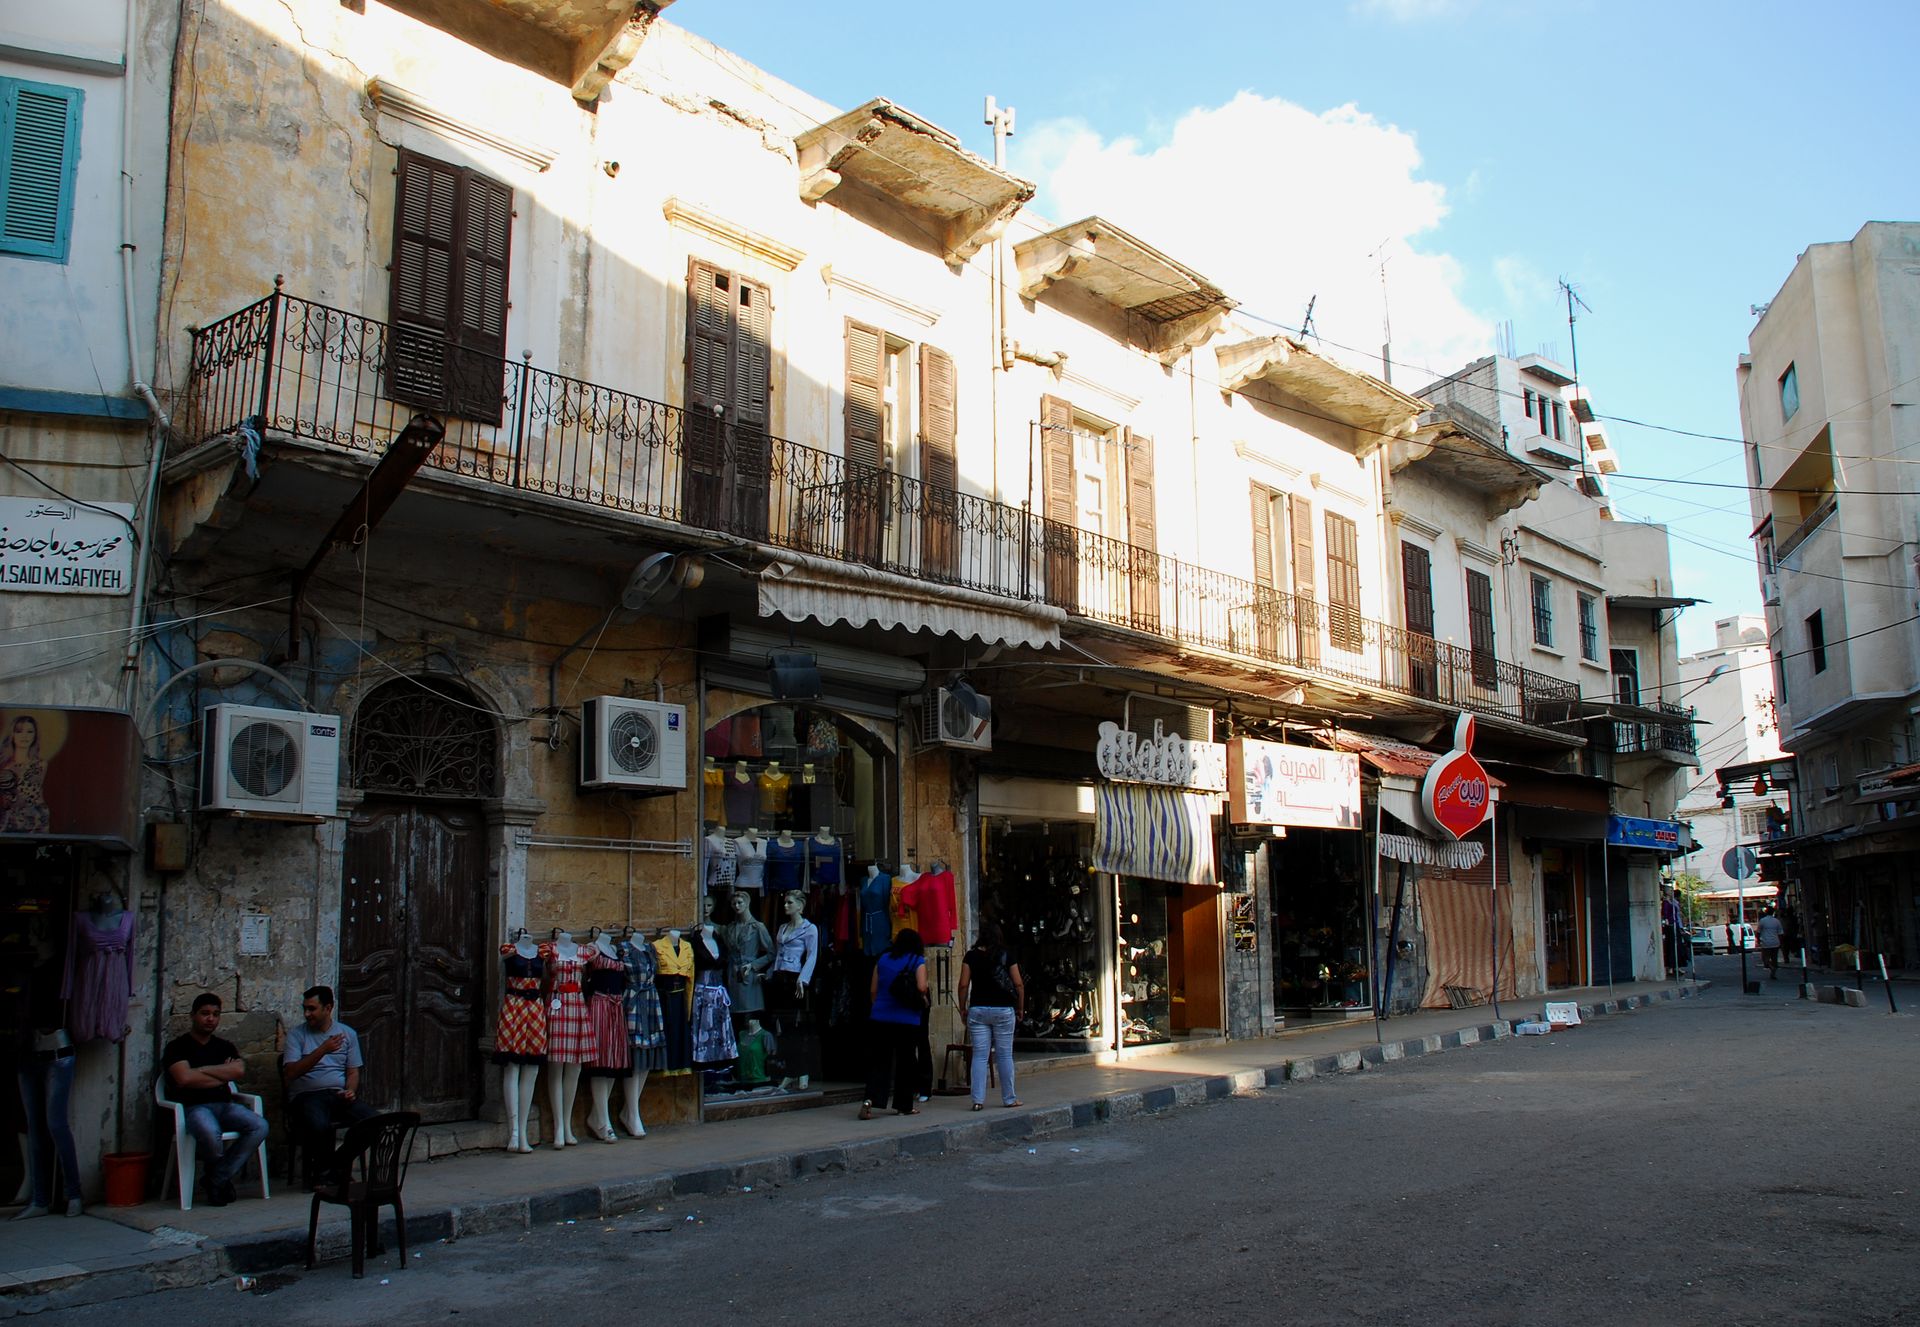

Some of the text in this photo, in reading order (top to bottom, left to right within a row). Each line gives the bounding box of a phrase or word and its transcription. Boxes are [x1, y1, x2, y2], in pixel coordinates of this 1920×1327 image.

[25, 504, 77, 520] الدكتور
[51, 539, 101, 562] سعيد
[86, 536, 122, 559] محمد
[44, 566, 121, 589] M.SAFIYEH
